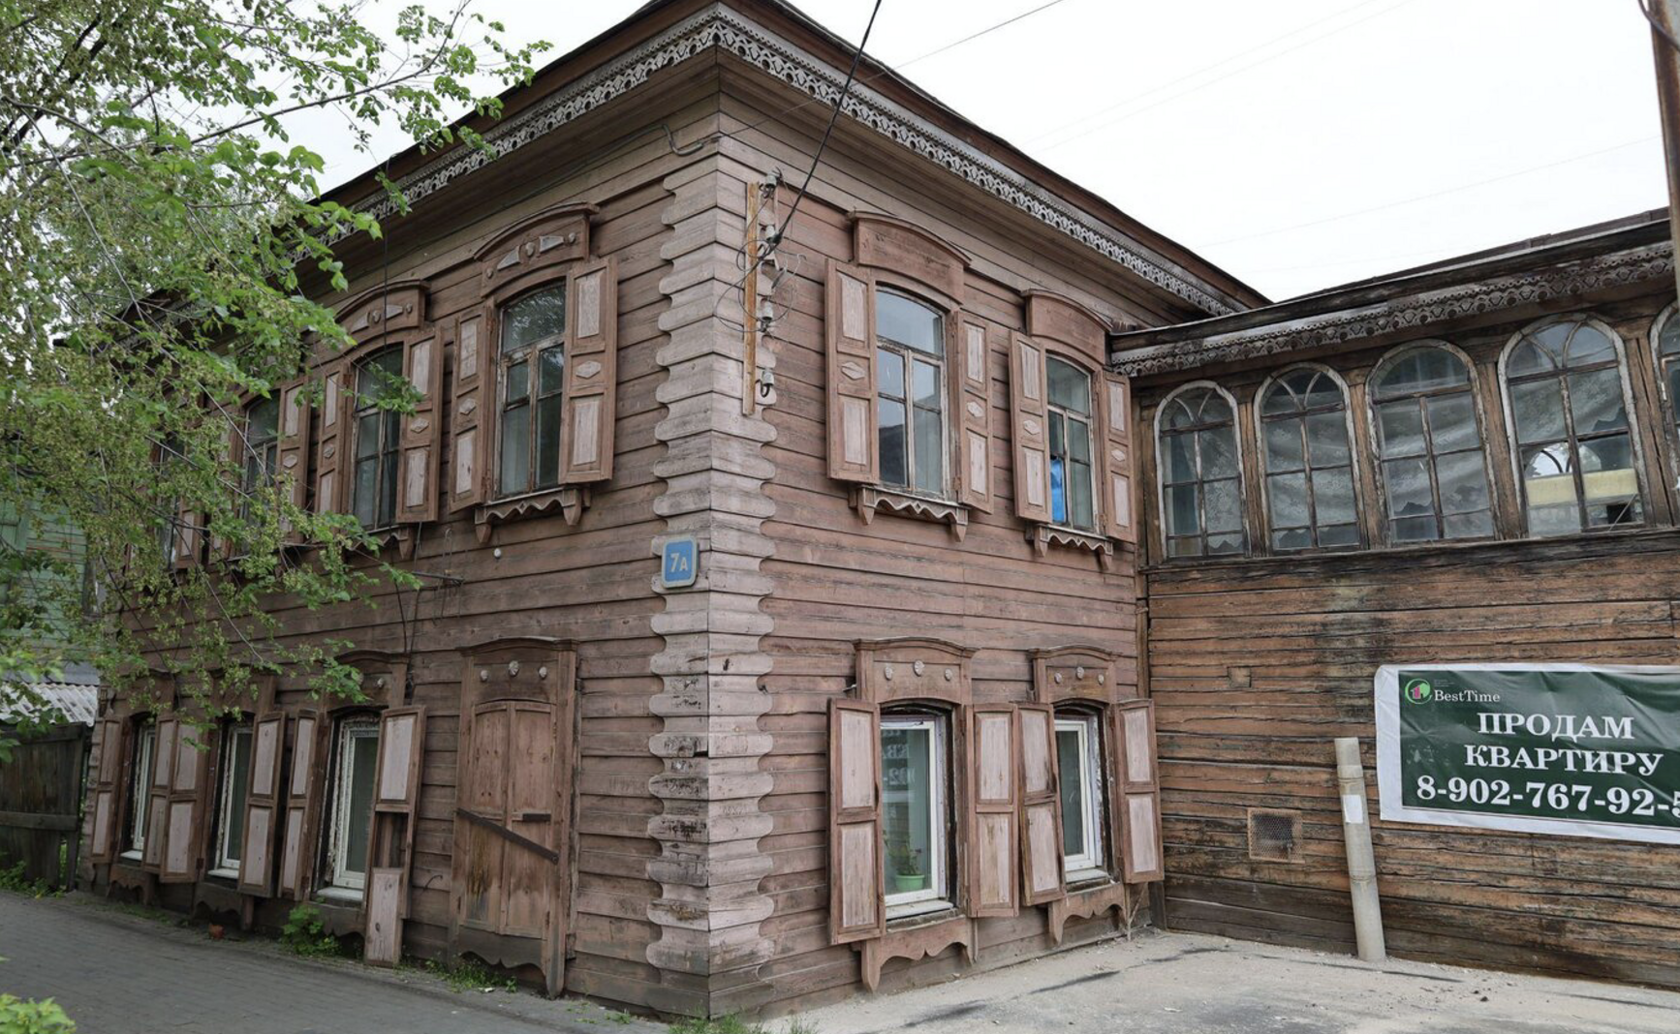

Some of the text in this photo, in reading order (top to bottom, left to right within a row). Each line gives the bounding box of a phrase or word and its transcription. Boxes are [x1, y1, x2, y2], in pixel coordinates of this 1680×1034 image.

[670, 552, 689, 573] 7А
[1434, 690, 1500, 702] BestTime
[1477, 712, 1635, 742] ПРОДАМ
[1464, 744, 1664, 776] КВАРТИРУ
